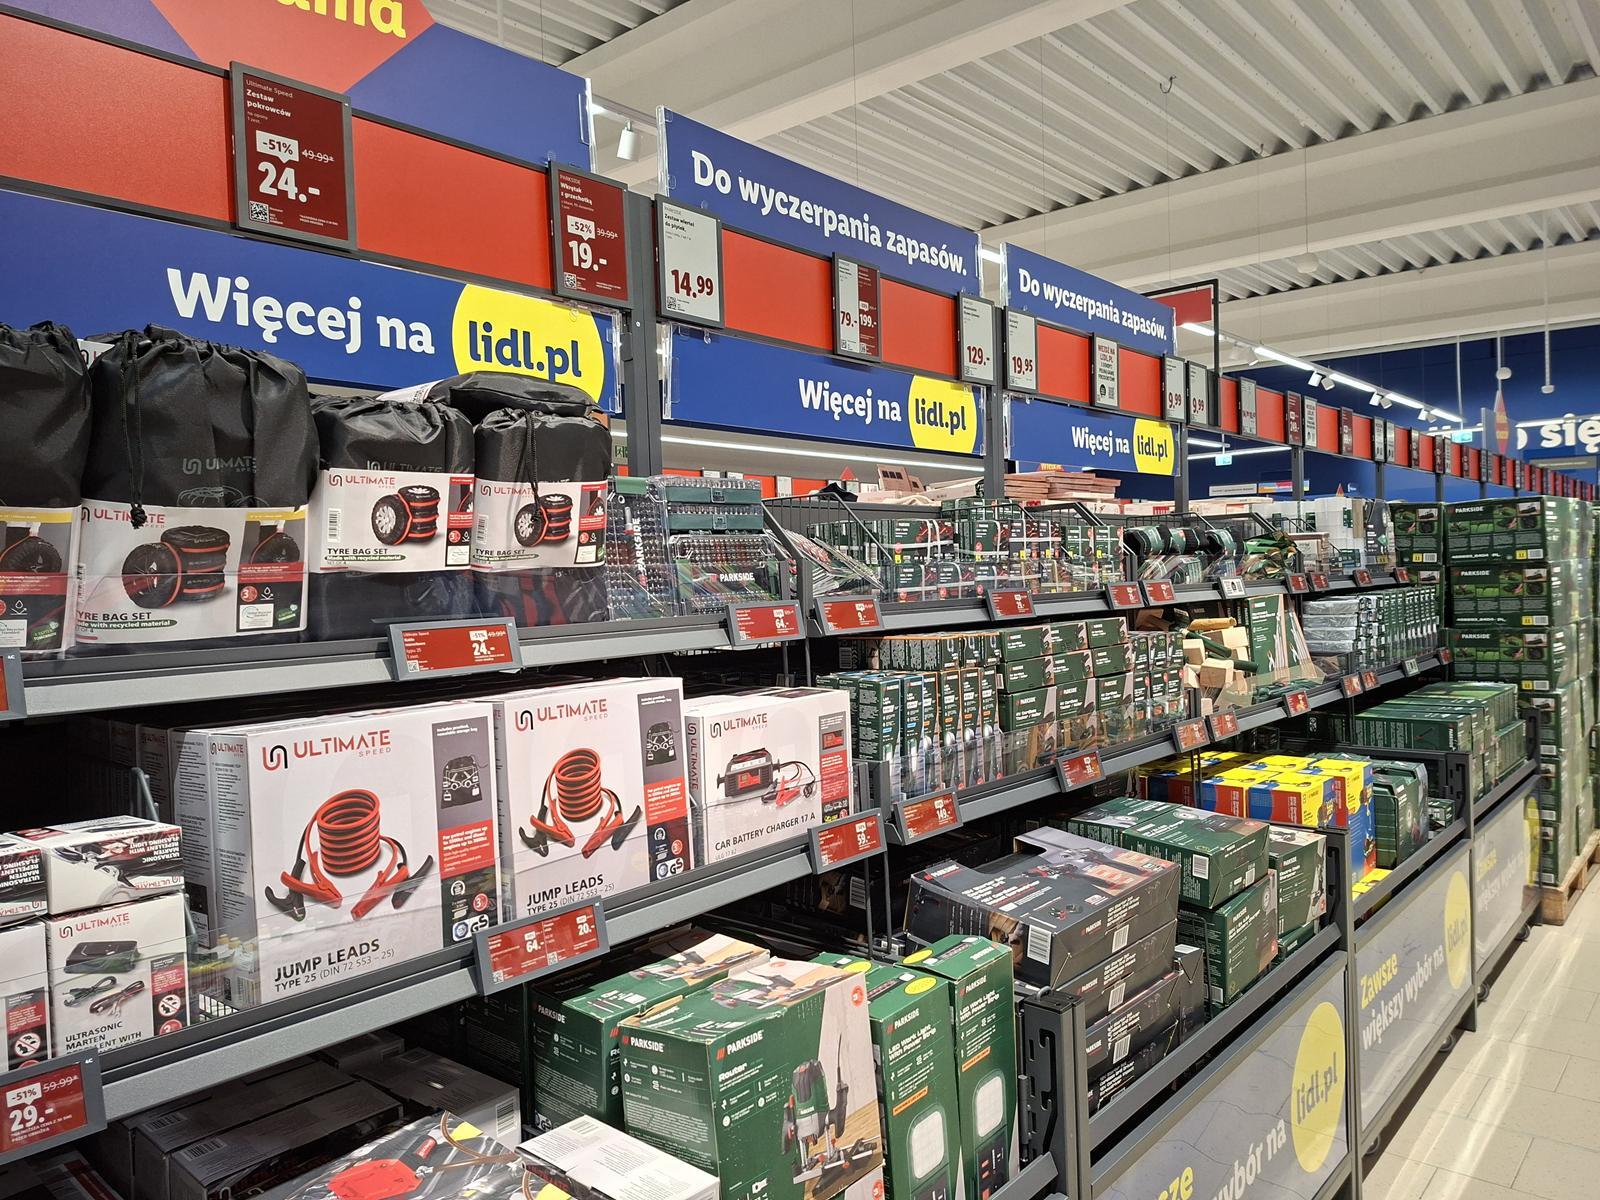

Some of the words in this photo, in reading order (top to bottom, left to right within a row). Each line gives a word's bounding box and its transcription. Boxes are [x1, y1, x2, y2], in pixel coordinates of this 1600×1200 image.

[246, 79, 272, 92] Ultimate
[247, 89, 273, 102] Zestaw
[247, 100, 291, 118] pokrowców
[262, 138, 293, 155] -51%
[258, 161, 320, 202] 24.-
[664, 213, 680, 222] Zestaw
[692, 150, 731, 194] Do
[739, 176, 881, 247] wyczerpania
[886, 230, 966, 275] zapasów.
[571, 221, 592, 234] -52%
[568, 240, 608, 271] 19.-
[671, 269, 714, 298] 14.99
[1019, 268, 1040, 296] Do
[1043, 282, 1120, 324] wyczerpania
[1121, 310, 1167, 341] zapasów.
[166, 267, 361, 354] Więcej
[377, 317, 434, 355] na
[469, 320, 582, 380] lidl.pl
[967, 345, 990, 366] 129.-
[1012, 356, 1033, 375] 19.95
[799, 378, 873, 425] Więcej
[878, 398, 901, 422] na
[915, 398, 967, 435] lidl.pl
[1168, 392, 1182, 408] 9.99
[1193, 397, 1204, 413] 9.99
[1072, 426, 1113, 457] Więcej
[1115, 438, 1130, 454] na
[1137, 436, 1168, 461] lidl.pl
[345, 475, 395, 485] ULTIMATE
[494, 487, 534, 495] ULTIMAT
[94, 507, 165, 523] ULTITE
[719, 572, 755, 582] PARKSIDE
[91, 620, 107, 628] with
[108, 620, 140, 629] recycled
[141, 619, 170, 627] material
[102, 612, 128, 621] BAG
[132, 612, 152, 620] SET
[472, 642, 495, 656] 24.-
[537, 699, 607, 722] ULTIMATE
[723, 712, 767, 731] ULTIMATE
[217, 743, 244, 754] ULTIMATE
[293, 729, 391, 758] ULTIMATE
[359, 746, 391, 758] SPEED
[690, 738, 698, 791] ULTIMATE
[715, 839, 731, 851] CAR
[732, 828, 764, 846] BATTERY
[766, 817, 799, 835] CHARGER
[801, 814, 808, 823] 17
[810, 812, 815, 820] A
[142, 852, 180, 863] ULTRASONIC
[154, 847, 180, 855] MARTEN
[9, 869, 40, 880] MARTEN
[670, 858, 683, 873] GS
[527, 886, 561, 907] JUMP
[565, 874, 604, 896] LEADS
[527, 904, 546, 916] TYPE
[548, 901, 558, 909] 25
[559, 896, 575, 907] (DIN
[577, 892, 585, 901] 72
[586, 889, 598, 898] 553
[604, 882, 615, 894] 25)
[475, 898, 481, 907] 3
[76, 913, 129, 931] ULTIMATE
[471, 915, 487, 932] GS
[275, 955, 322, 982] JUMP
[327, 938, 380, 966] LEADS
[275, 978, 300, 992] TYPE
[304, 973, 316, 984] 25
[320, 965, 340, 979] (DIN
[343, 961, 354, 972] 72
[357, 956, 372, 967] 553
[381, 948, 395, 963] 25)
[966, 975, 986, 993] PARKSIDE
[1361, 953, 1398, 1009] Zawsze
[1363, 985, 1404, 1050] większy
[1405, 960, 1433, 1007] wybór
[1434, 945, 1443, 969] na
[537, 1004, 566, 1024] PARKSIDE
[894, 1008, 919, 1030] PARKSIDE
[65, 1021, 123, 1042] ULTRASONIC
[119, 1032, 142, 1044] WITH
[889, 1042, 901, 1054] LED
[901, 1033, 916, 1046] Work
[917, 1024, 931, 1038] Light
[66, 1034, 106, 1050] MARTEN
[631, 1036, 664, 1053] PARKSIDE
[727, 1031, 763, 1055] PARKSIDE
[889, 1050, 903, 1060] With
[903, 1036, 922, 1053] Power
[922, 1027, 936, 1041] Strip
[719, 1063, 747, 1082] Router
[12, 1088, 37, 1101] -51%
[1296, 1052, 1338, 1125] lidl.pl
[9, 1105, 54, 1132] 29.-
[1266, 1119, 1287, 1160] na
